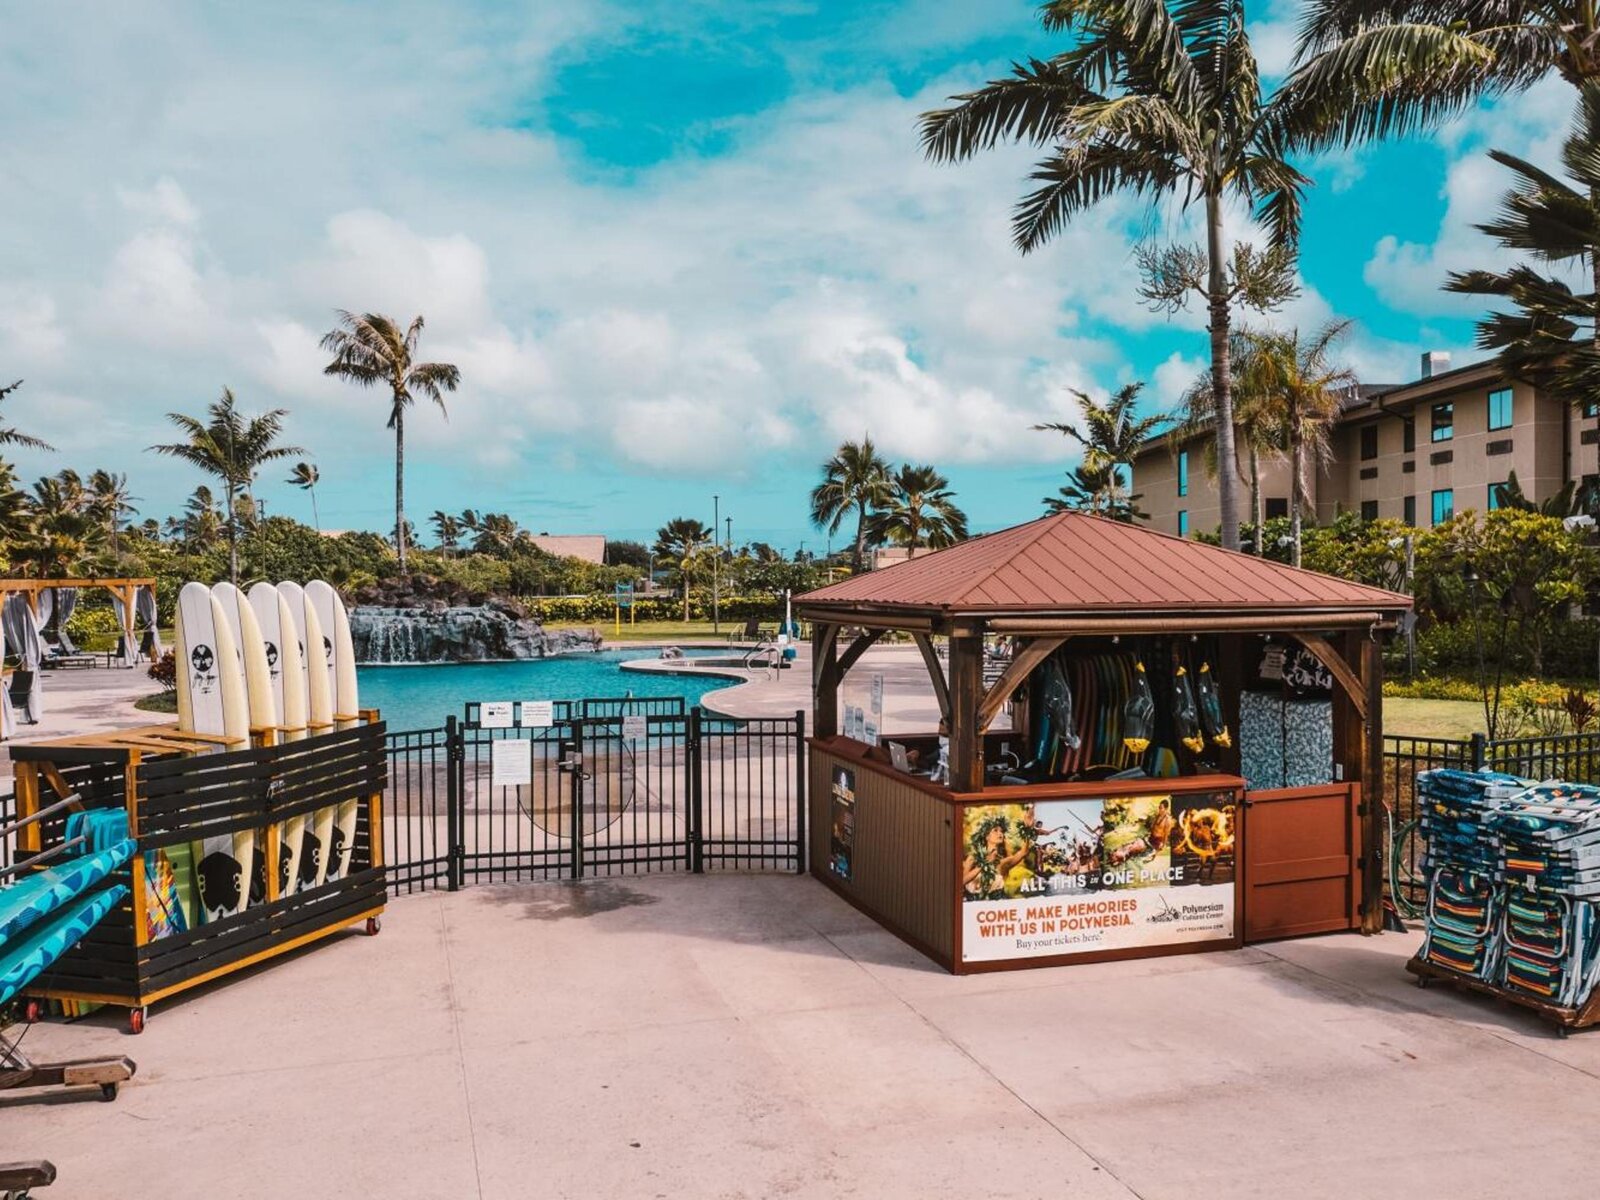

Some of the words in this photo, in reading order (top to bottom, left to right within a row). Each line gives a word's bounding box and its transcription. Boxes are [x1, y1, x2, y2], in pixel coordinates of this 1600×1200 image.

[1020, 878, 1045, 892] ALL
[1052, 875, 1086, 889] THIS
[1102, 871, 1135, 885] ONE
[1140, 867, 1184, 882] PLACE
[976, 909, 1022, 923] COME,
[1026, 906, 1062, 920] MAKE
[1067, 900, 1137, 916] MEMORIES
[1182, 904, 1224, 914] Polynesian
[979, 924, 1015, 938] WITH
[1020, 922, 1037, 935] US
[1042, 921, 1055, 933] IN
[1060, 914, 1134, 932] POLYNESIA.
[1016, 939, 1032, 949] Buy
[1034, 938, 1052, 949] your
[1054, 935, 1081, 946] tickets
